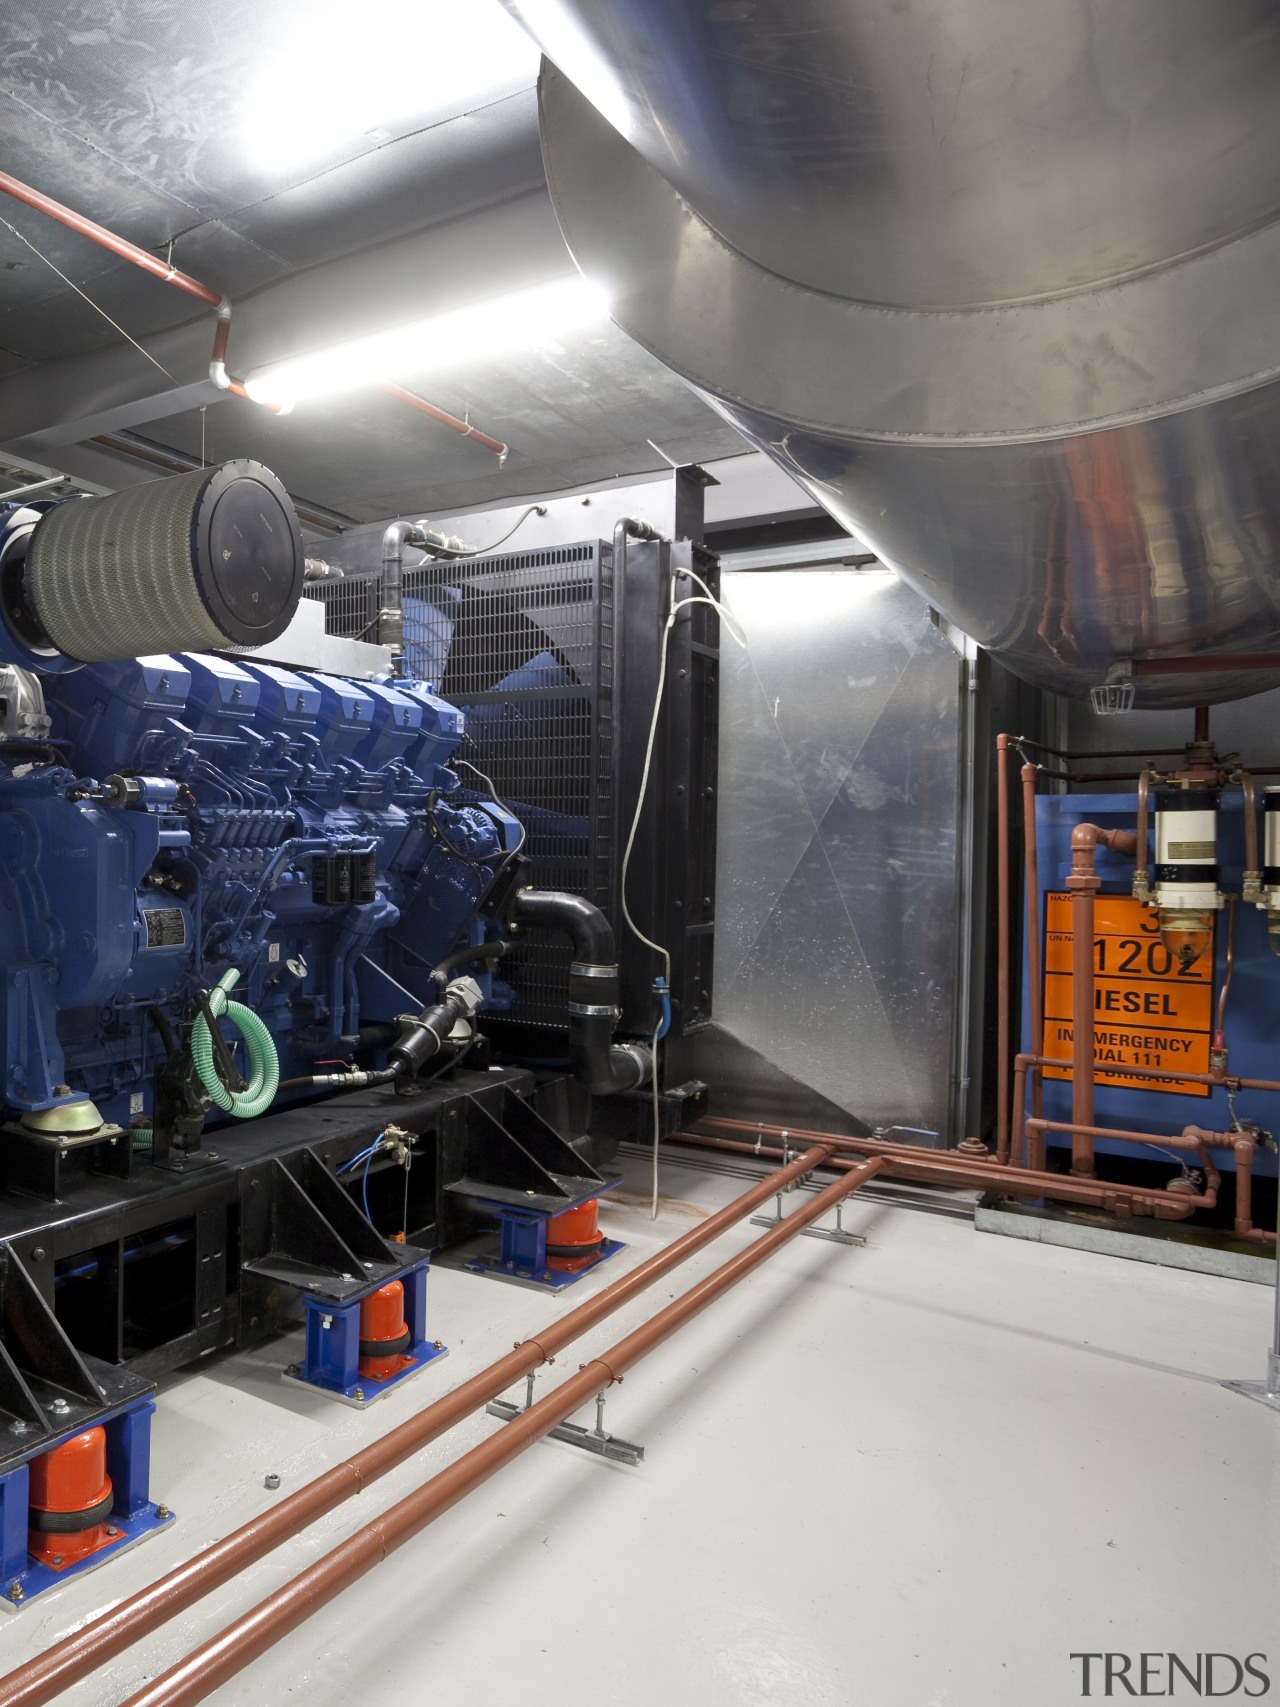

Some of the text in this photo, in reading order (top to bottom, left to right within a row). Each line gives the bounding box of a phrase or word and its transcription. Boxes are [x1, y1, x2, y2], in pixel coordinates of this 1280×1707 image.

[1094, 989, 1178, 1017] IESEL
[1057, 1028, 1193, 1053] IN MERGENCY
[1132, 1051, 1161, 1067] 111
